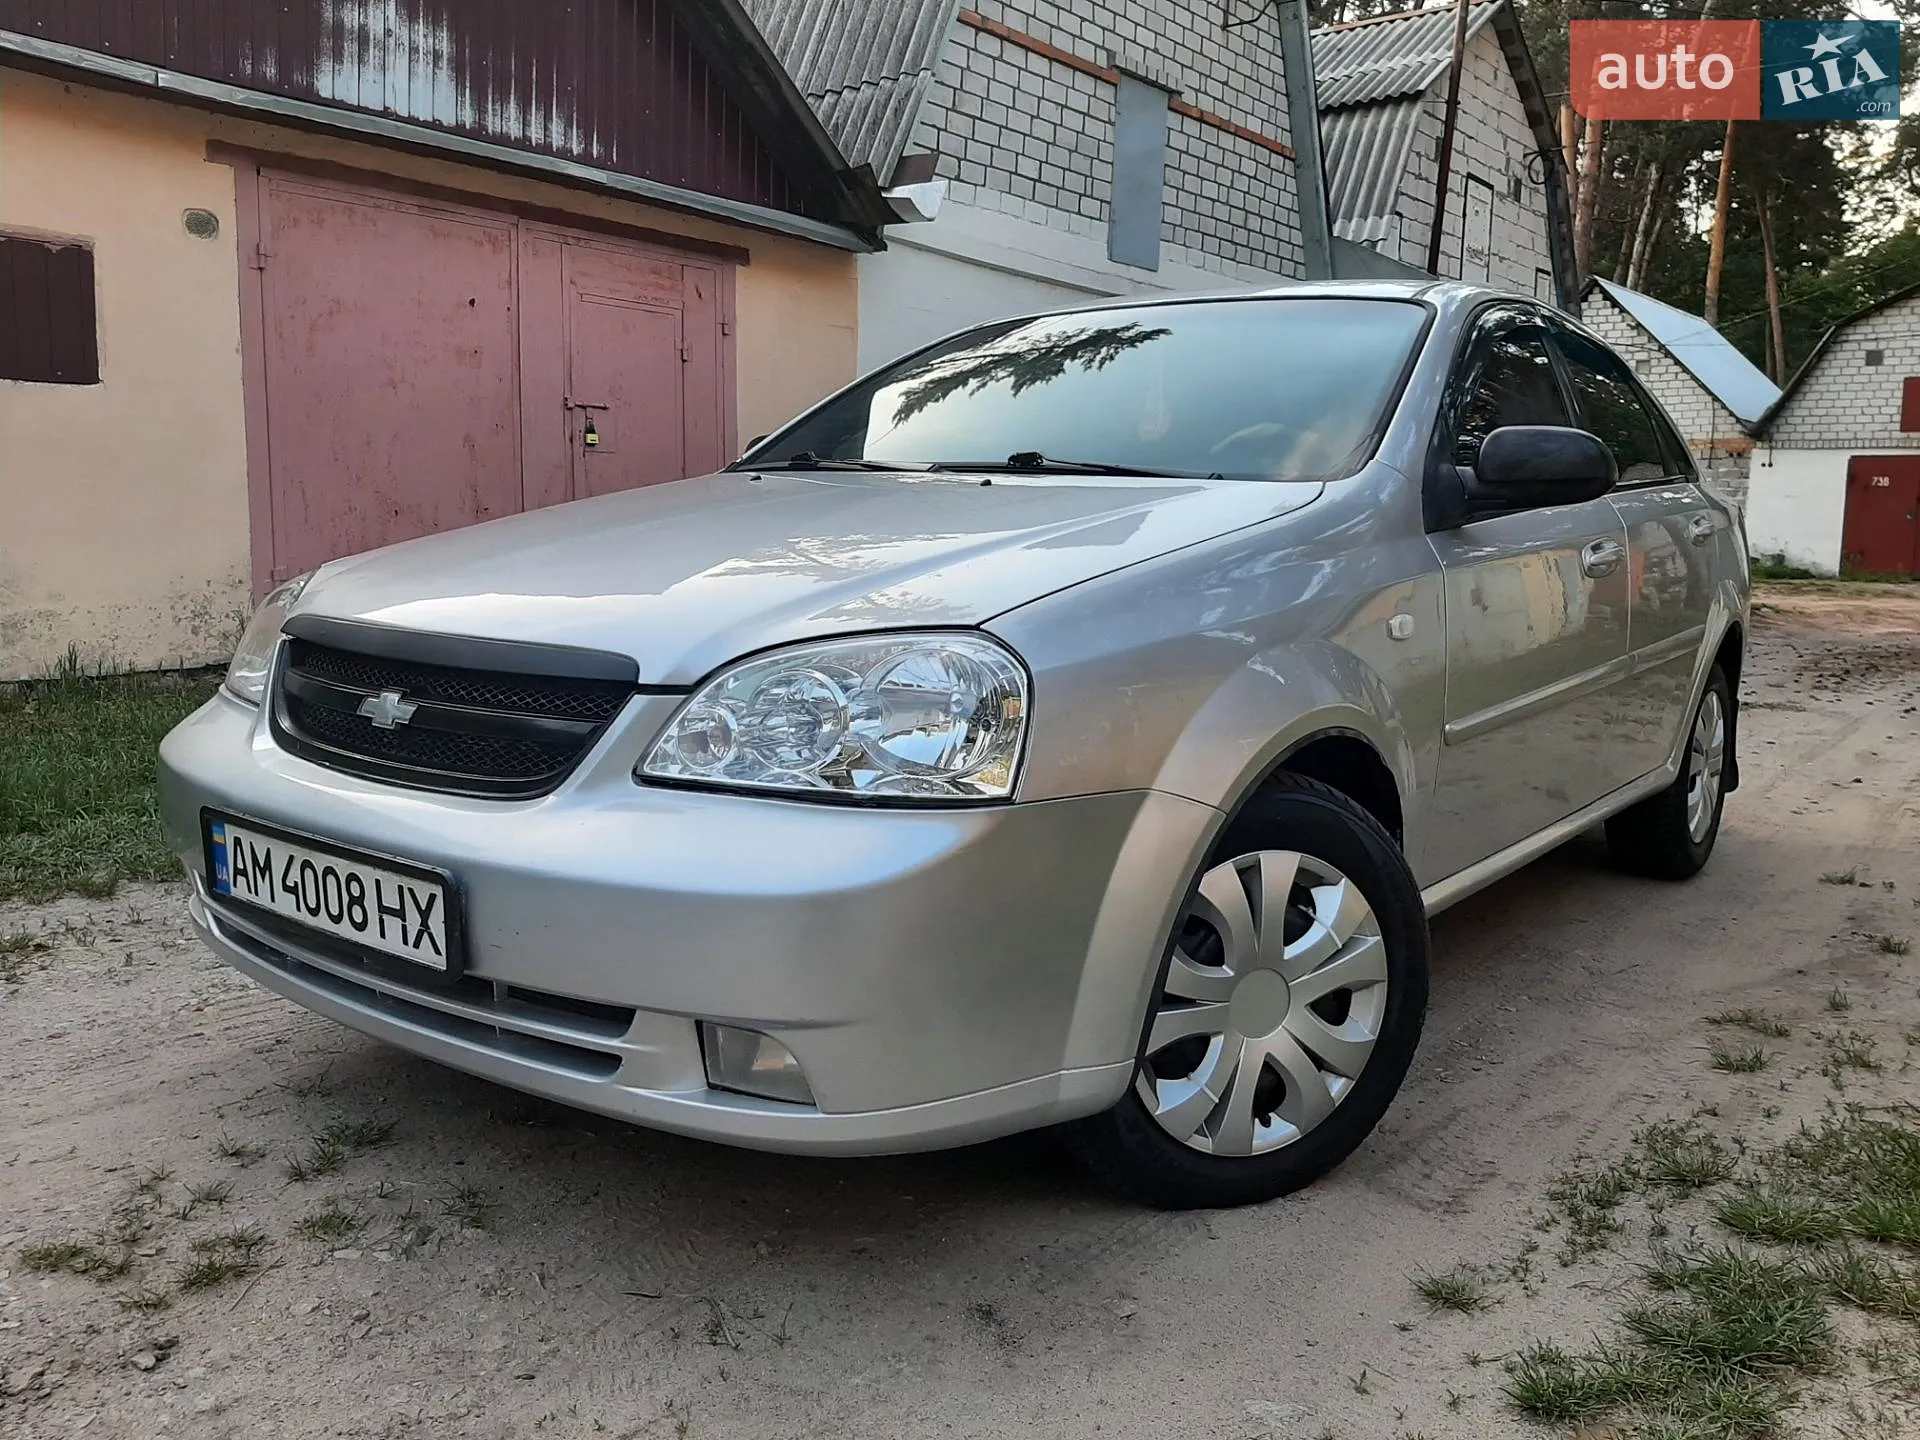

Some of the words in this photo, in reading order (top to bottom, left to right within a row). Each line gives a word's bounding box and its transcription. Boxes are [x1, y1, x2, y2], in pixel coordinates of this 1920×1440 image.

[215, 862, 229, 882] UA
[233, 836, 276, 903] AM
[281, 854, 369, 932] 4008
[375, 878, 442, 956] HX
